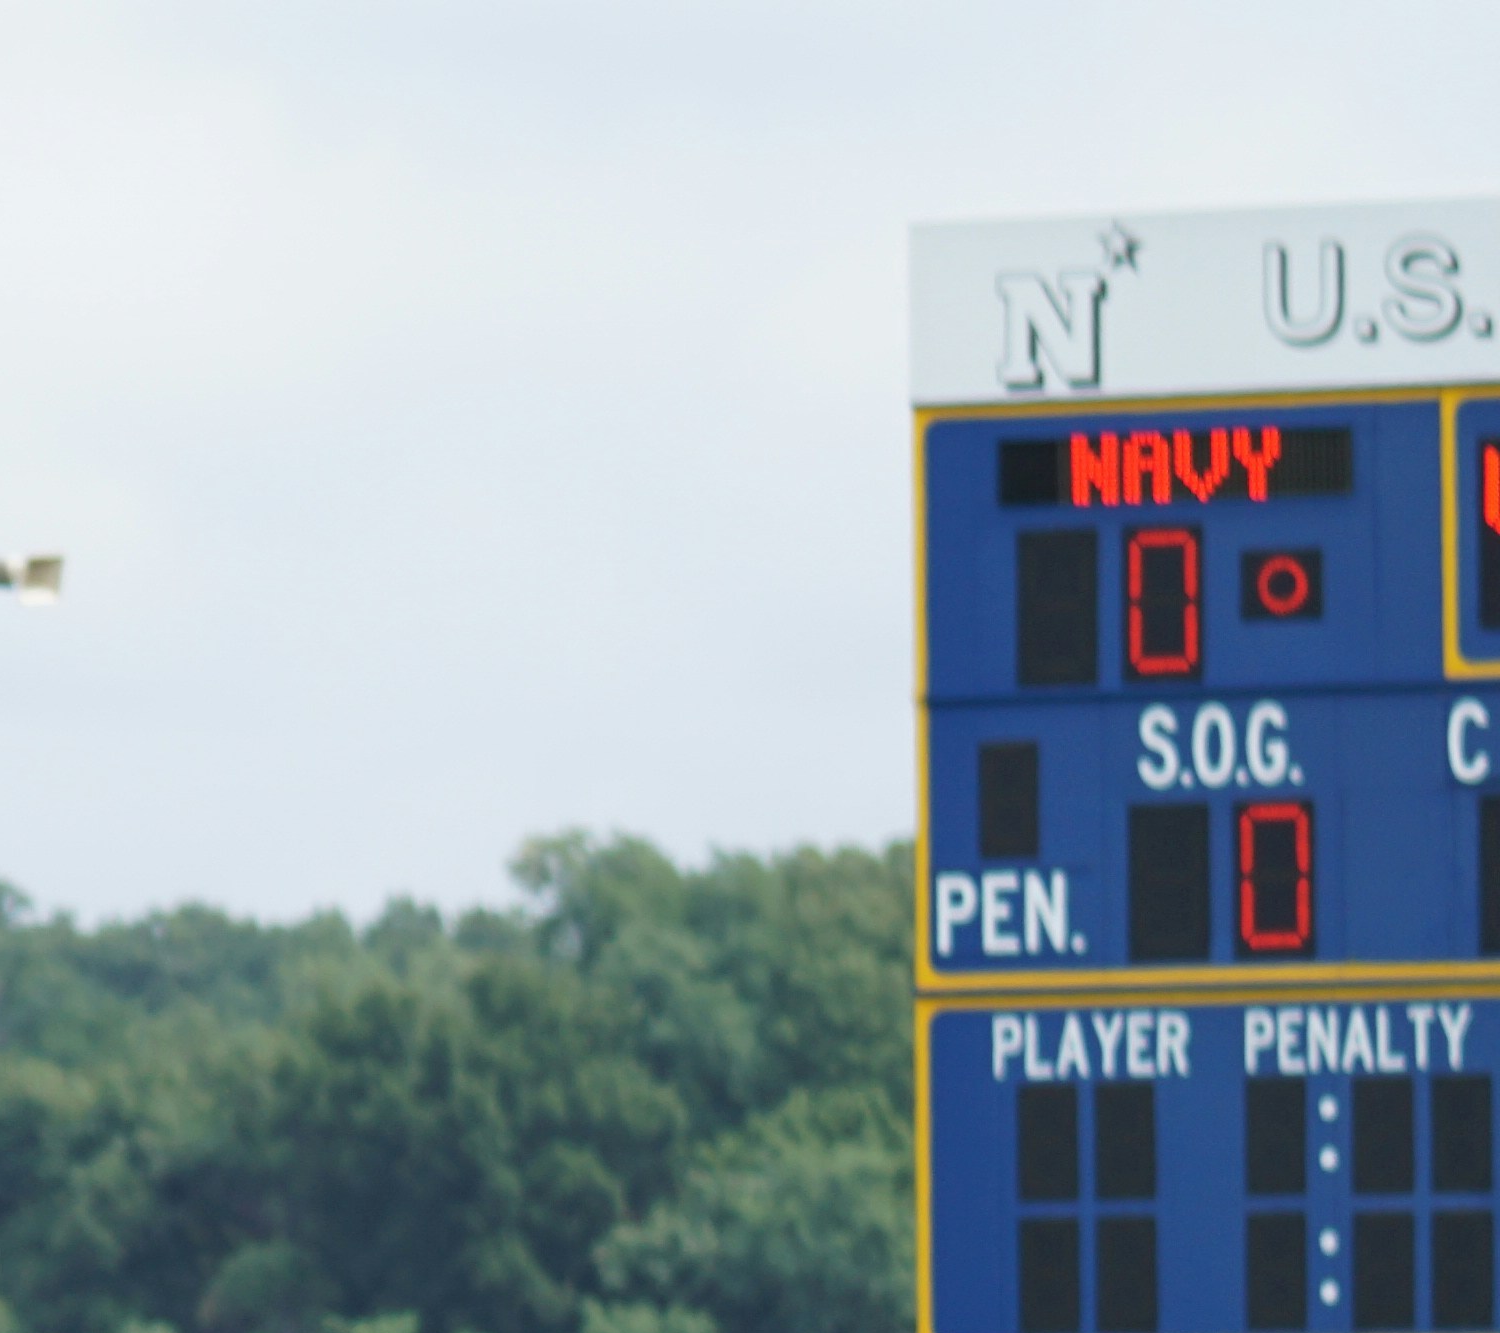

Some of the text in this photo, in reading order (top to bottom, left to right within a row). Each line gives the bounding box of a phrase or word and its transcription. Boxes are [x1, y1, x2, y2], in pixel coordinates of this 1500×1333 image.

[996, 271, 1107, 390] N
[1264, 235, 1495, 348] U.S.
[1070, 426, 1282, 508] NAVY
[1129, 529, 1198, 675] 0
[1137, 701, 1304, 789] S.O.G.
[936, 871, 1087, 956] PEN.
[1241, 803, 1310, 949] 0
[991, 1003, 1473, 1080] PLAYER PENALTY
